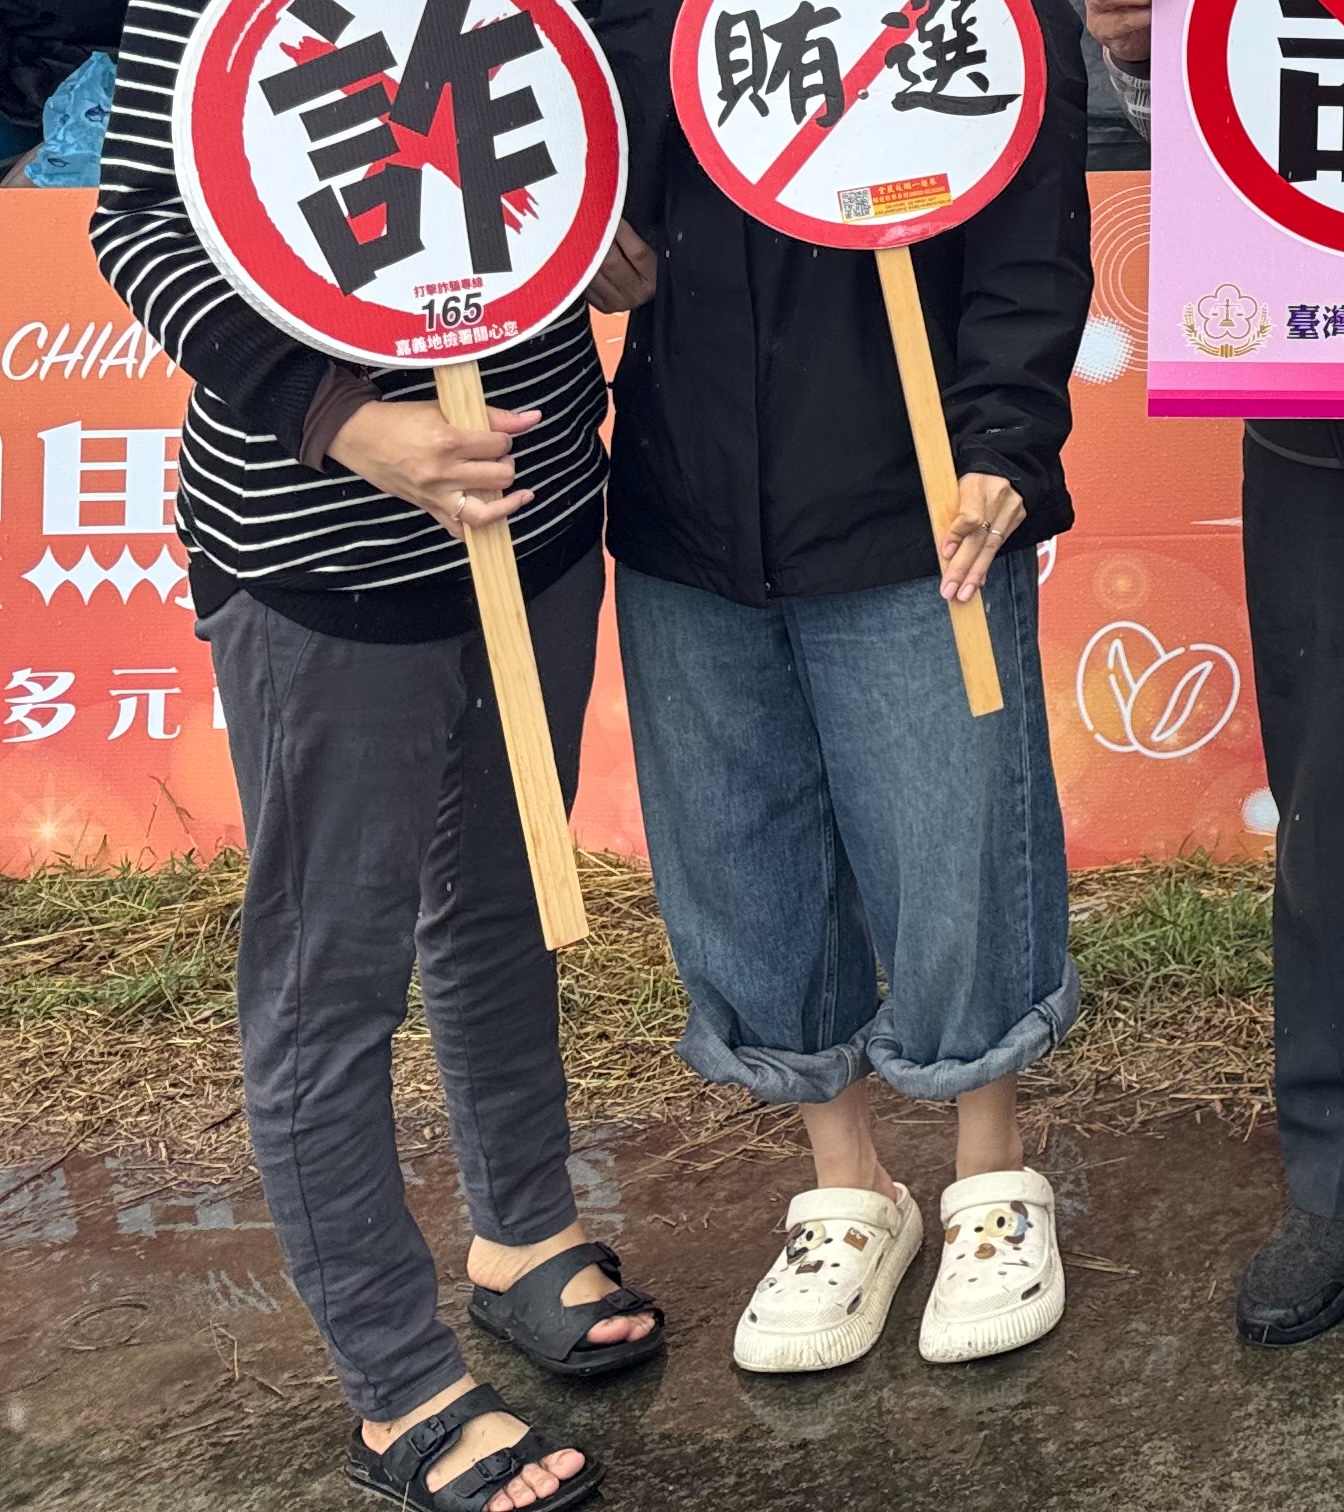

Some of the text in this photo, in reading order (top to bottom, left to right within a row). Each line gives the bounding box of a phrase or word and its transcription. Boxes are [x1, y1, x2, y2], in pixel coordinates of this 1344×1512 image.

[421, 291, 482, 331] 165
[394, 320, 520, 358] 嘉義地檢署關心您
[2, 666, 226, 744] 多元
